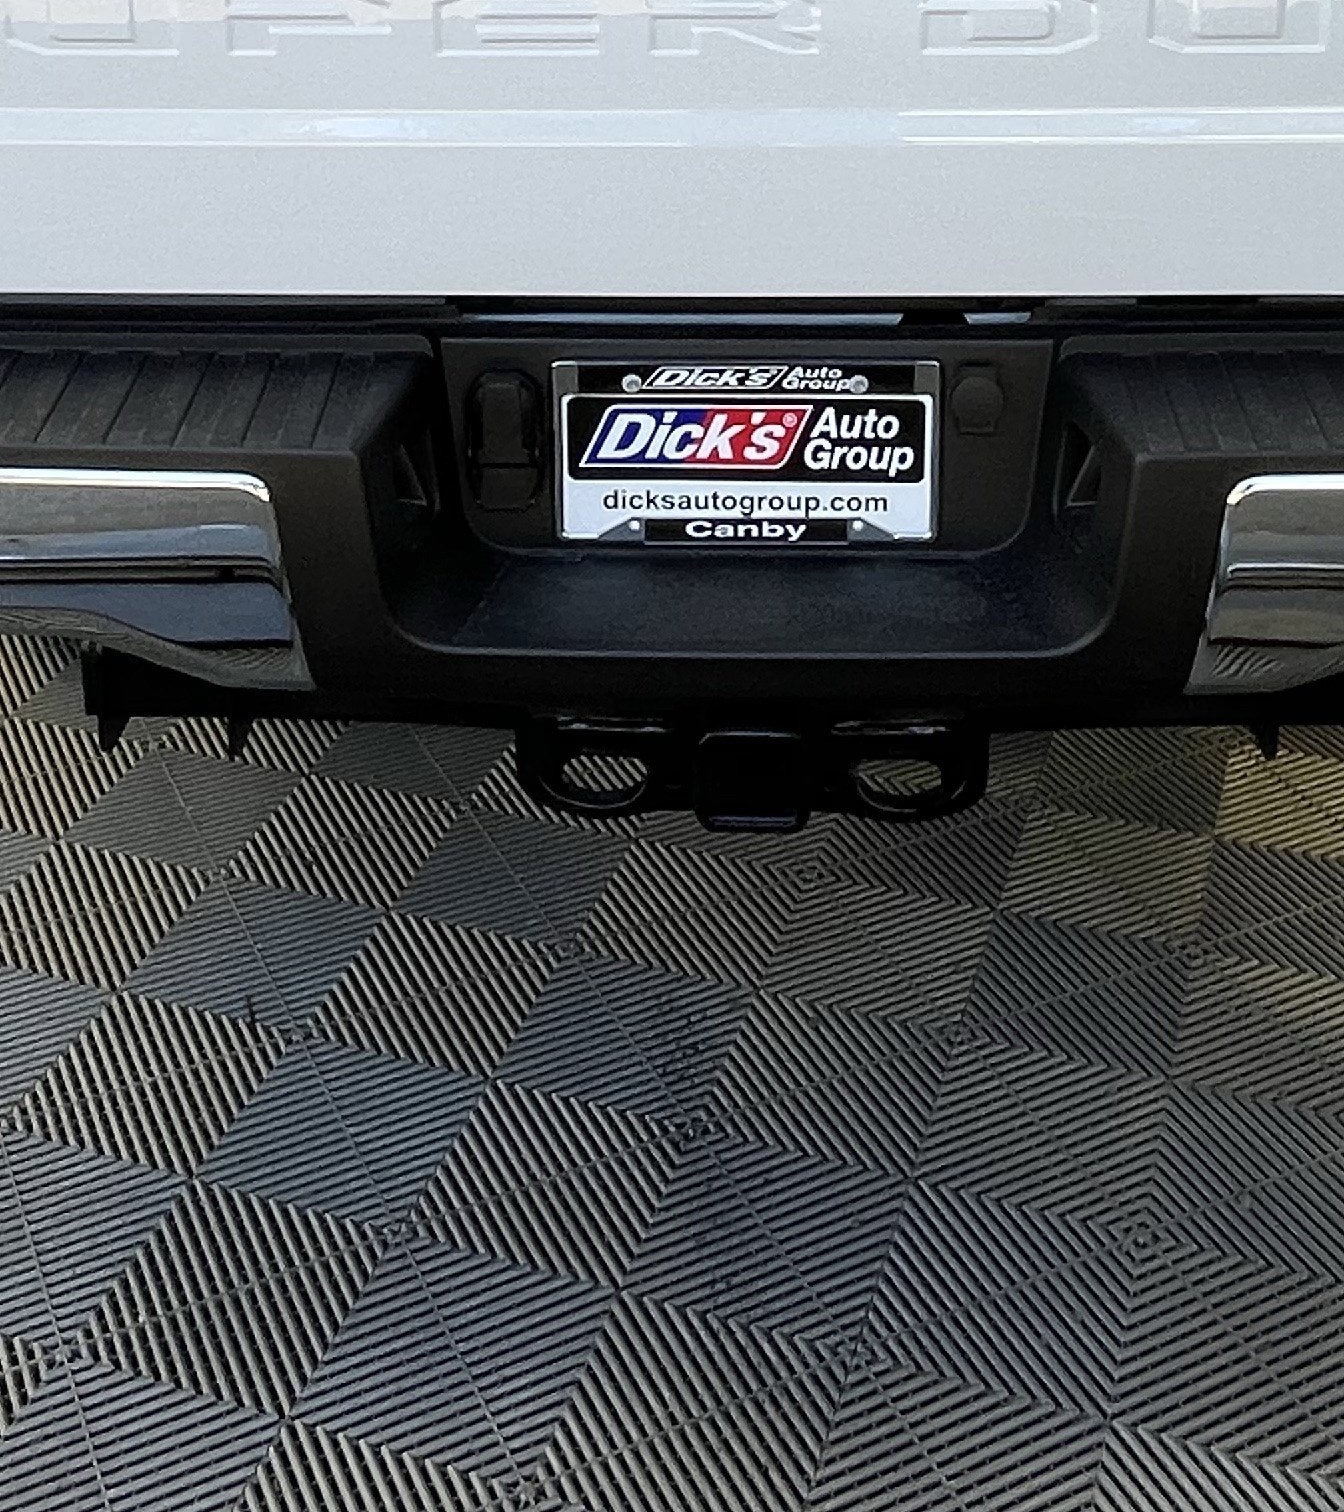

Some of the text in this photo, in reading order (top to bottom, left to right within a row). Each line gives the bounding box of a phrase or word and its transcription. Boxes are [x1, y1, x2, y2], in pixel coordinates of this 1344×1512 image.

[782, 377, 854, 391] Group
[791, 366, 843, 378] Auto
[596, 407, 900, 460] Dick's Auto
[803, 438, 915, 477] Group
[602, 489, 888, 518] dicksautogroup.com
[685, 520, 807, 542] Canby
